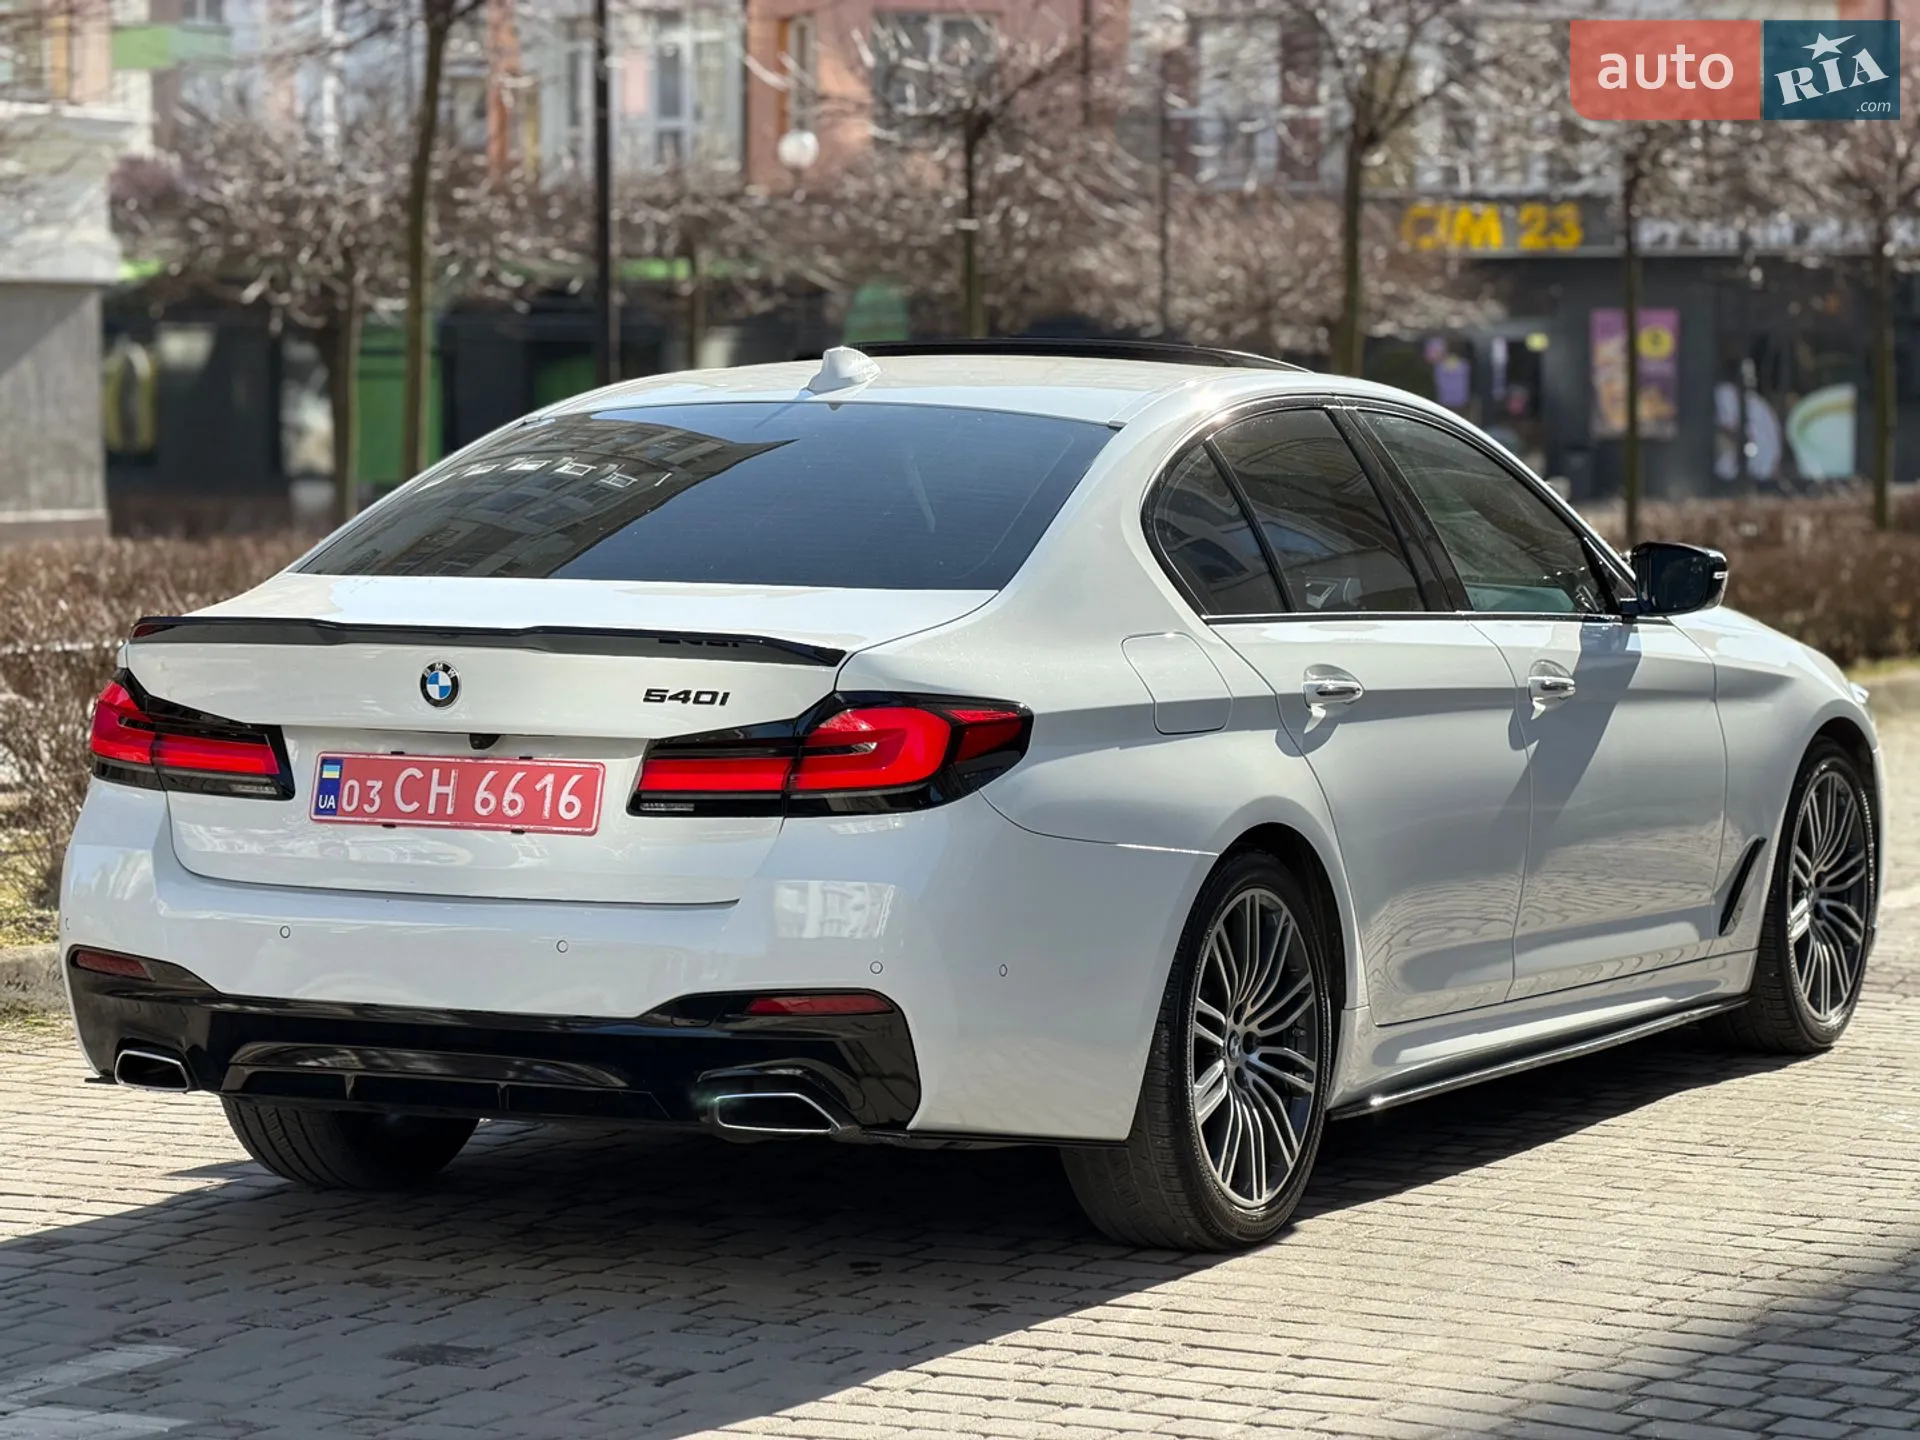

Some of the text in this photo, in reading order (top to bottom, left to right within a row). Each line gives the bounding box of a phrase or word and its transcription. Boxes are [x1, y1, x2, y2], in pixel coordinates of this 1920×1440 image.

[1518, 203, 1584, 249] 23
[318, 794, 336, 809] UA
[341, 767, 583, 820] 03 CH 6616
